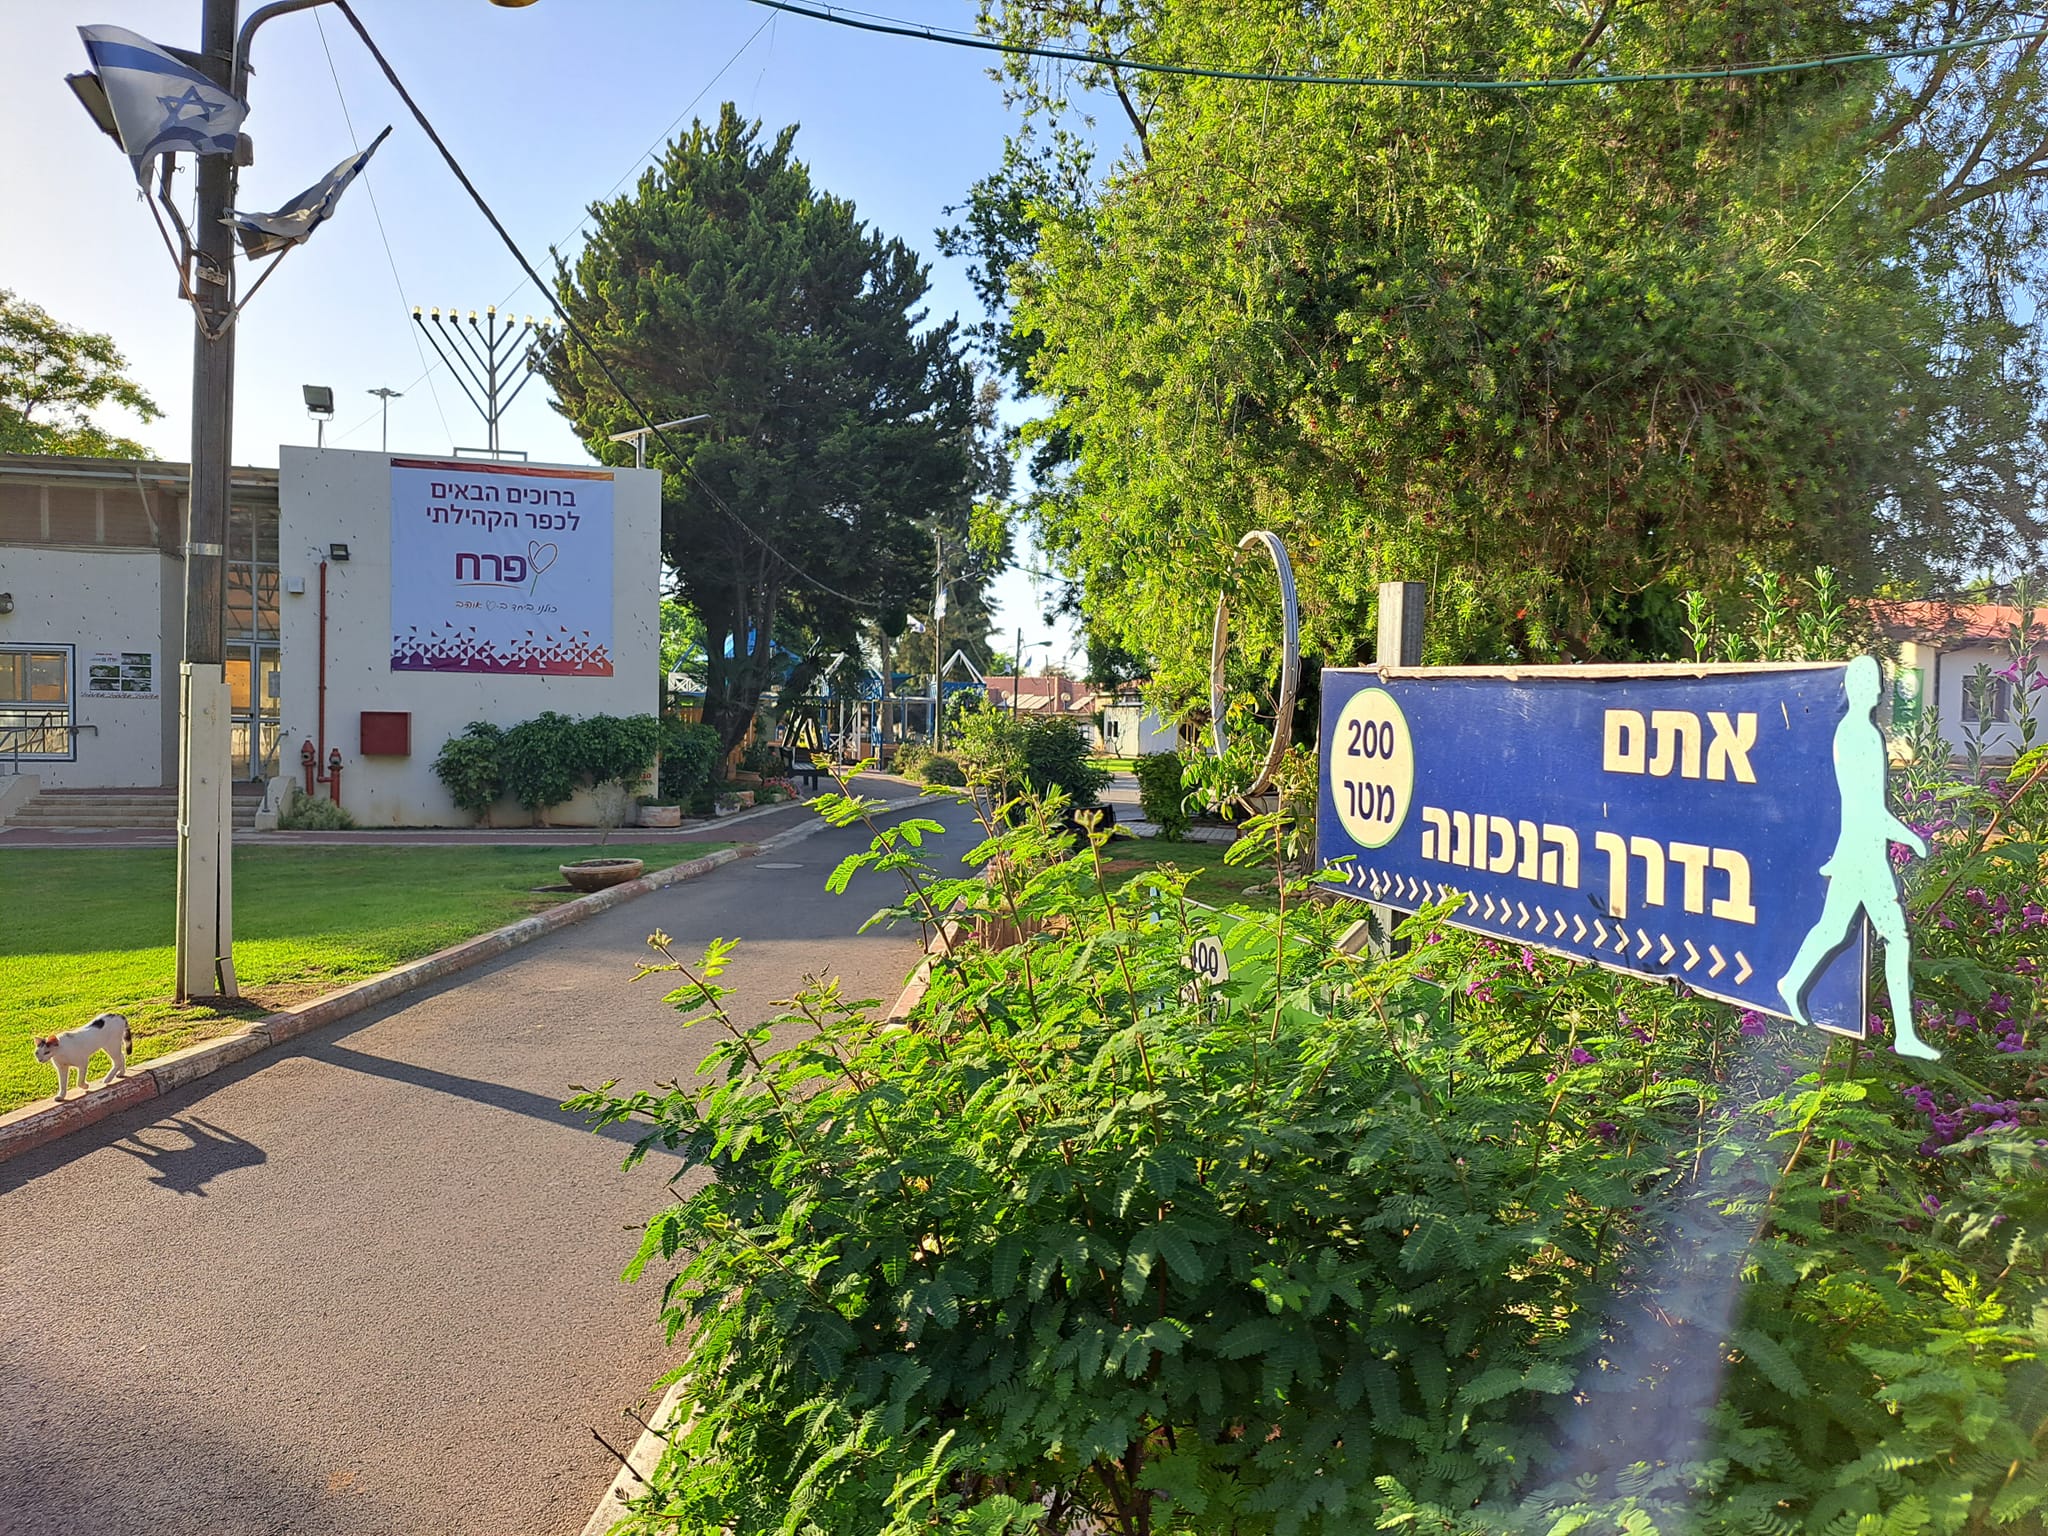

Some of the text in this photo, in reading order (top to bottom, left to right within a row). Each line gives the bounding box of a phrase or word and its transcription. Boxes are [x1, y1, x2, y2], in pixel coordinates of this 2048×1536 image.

[431, 482, 577, 507] ברוכים הבאים
[426, 504, 581, 532] לכפר הקהילתי
[455, 553, 527, 582] פרח
[1347, 718, 1394, 761] 200
[1602, 708, 1758, 784] אתם
[1343, 779, 1395, 824] מטר
[1421, 805, 1756, 925] בדרך הנכונה
